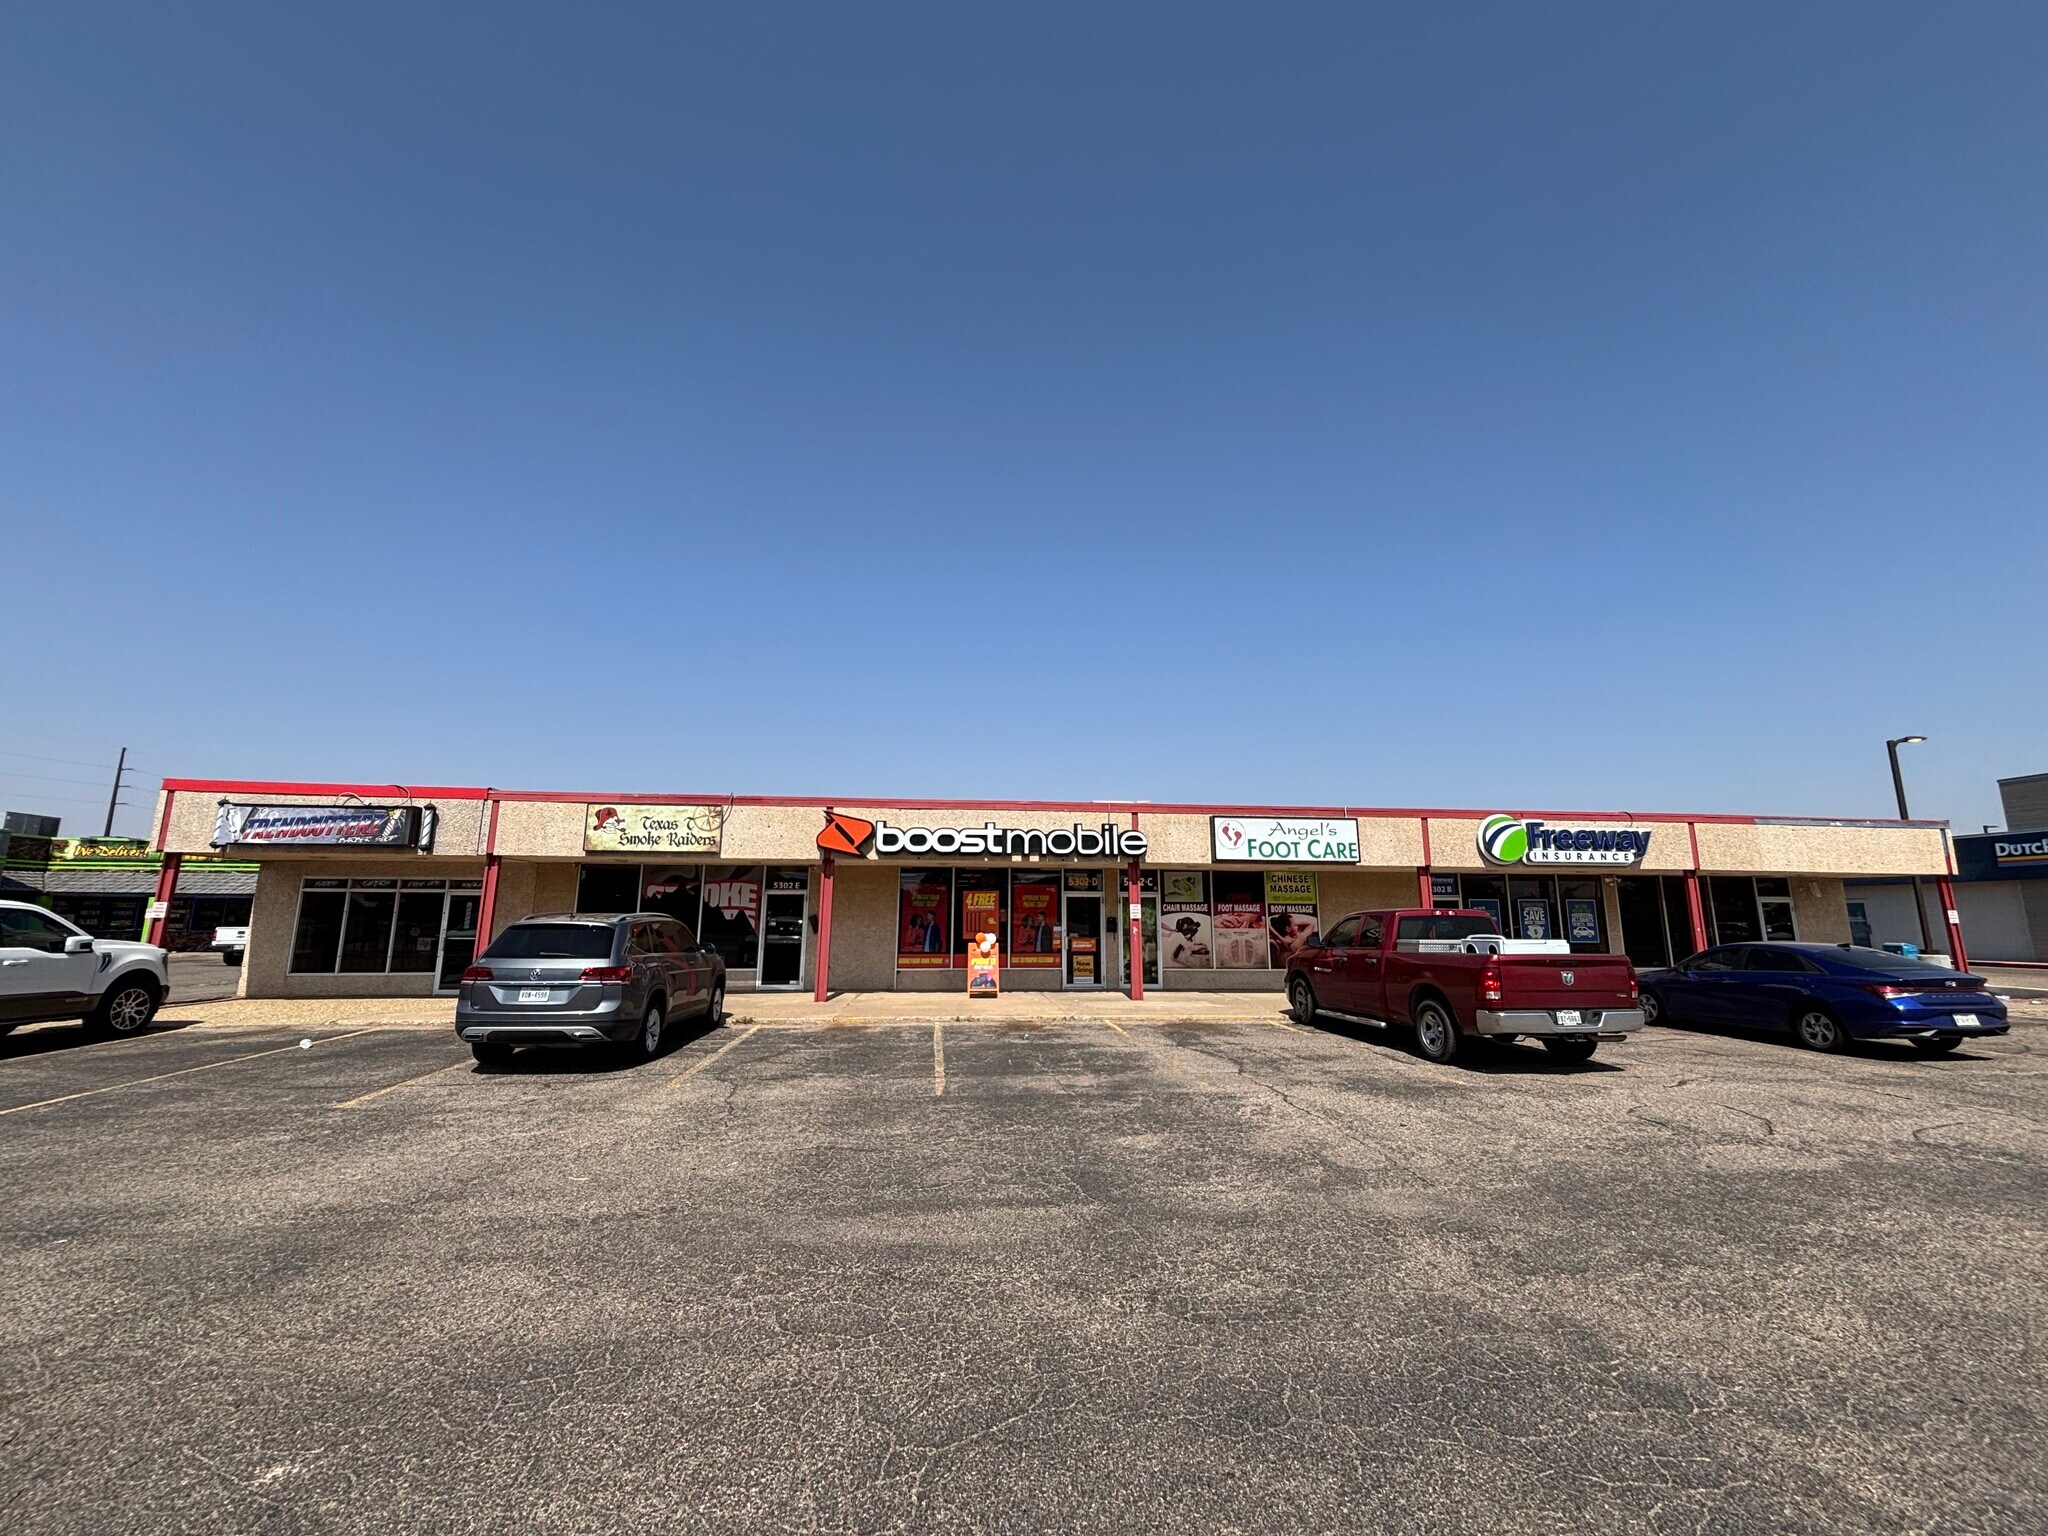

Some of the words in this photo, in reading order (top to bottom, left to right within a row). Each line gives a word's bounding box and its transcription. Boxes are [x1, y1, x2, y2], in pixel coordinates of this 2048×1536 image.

[640, 816, 679, 831] Texas
[1267, 821, 1337, 839] Angel's
[617, 832, 662, 848] Smoke
[666, 832, 717, 848] Raiders
[876, 821, 1148, 855] boostmobile
[1525, 822, 1652, 858] Freeway
[74, 844, 96, 857] We
[98, 844, 150, 858] Deliver!
[1247, 838, 1301, 858] FOOT
[1307, 838, 1358, 859] CARE
[1533, 852, 1630, 861] INSURANCE
[1271, 874, 1309, 883] CHINESE
[773, 881, 794, 889] 5302
[1270, 884, 1312, 893] MASSAGE
[966, 893, 973, 906] 4
[973, 893, 997, 906] FREE
[1162, 903, 1180, 912] CHAIR
[1181, 903, 1208, 912] MASSAGE
[1217, 903, 1233, 912] FOOT
[1233, 903, 1261, 912] MASSAGE
[1270, 904, 1286, 913] BODY
[1286, 904, 1313, 913] MASSAGE
[1523, 910, 1545, 921] SAVE
[1074, 966, 1093, 975] Hiring
